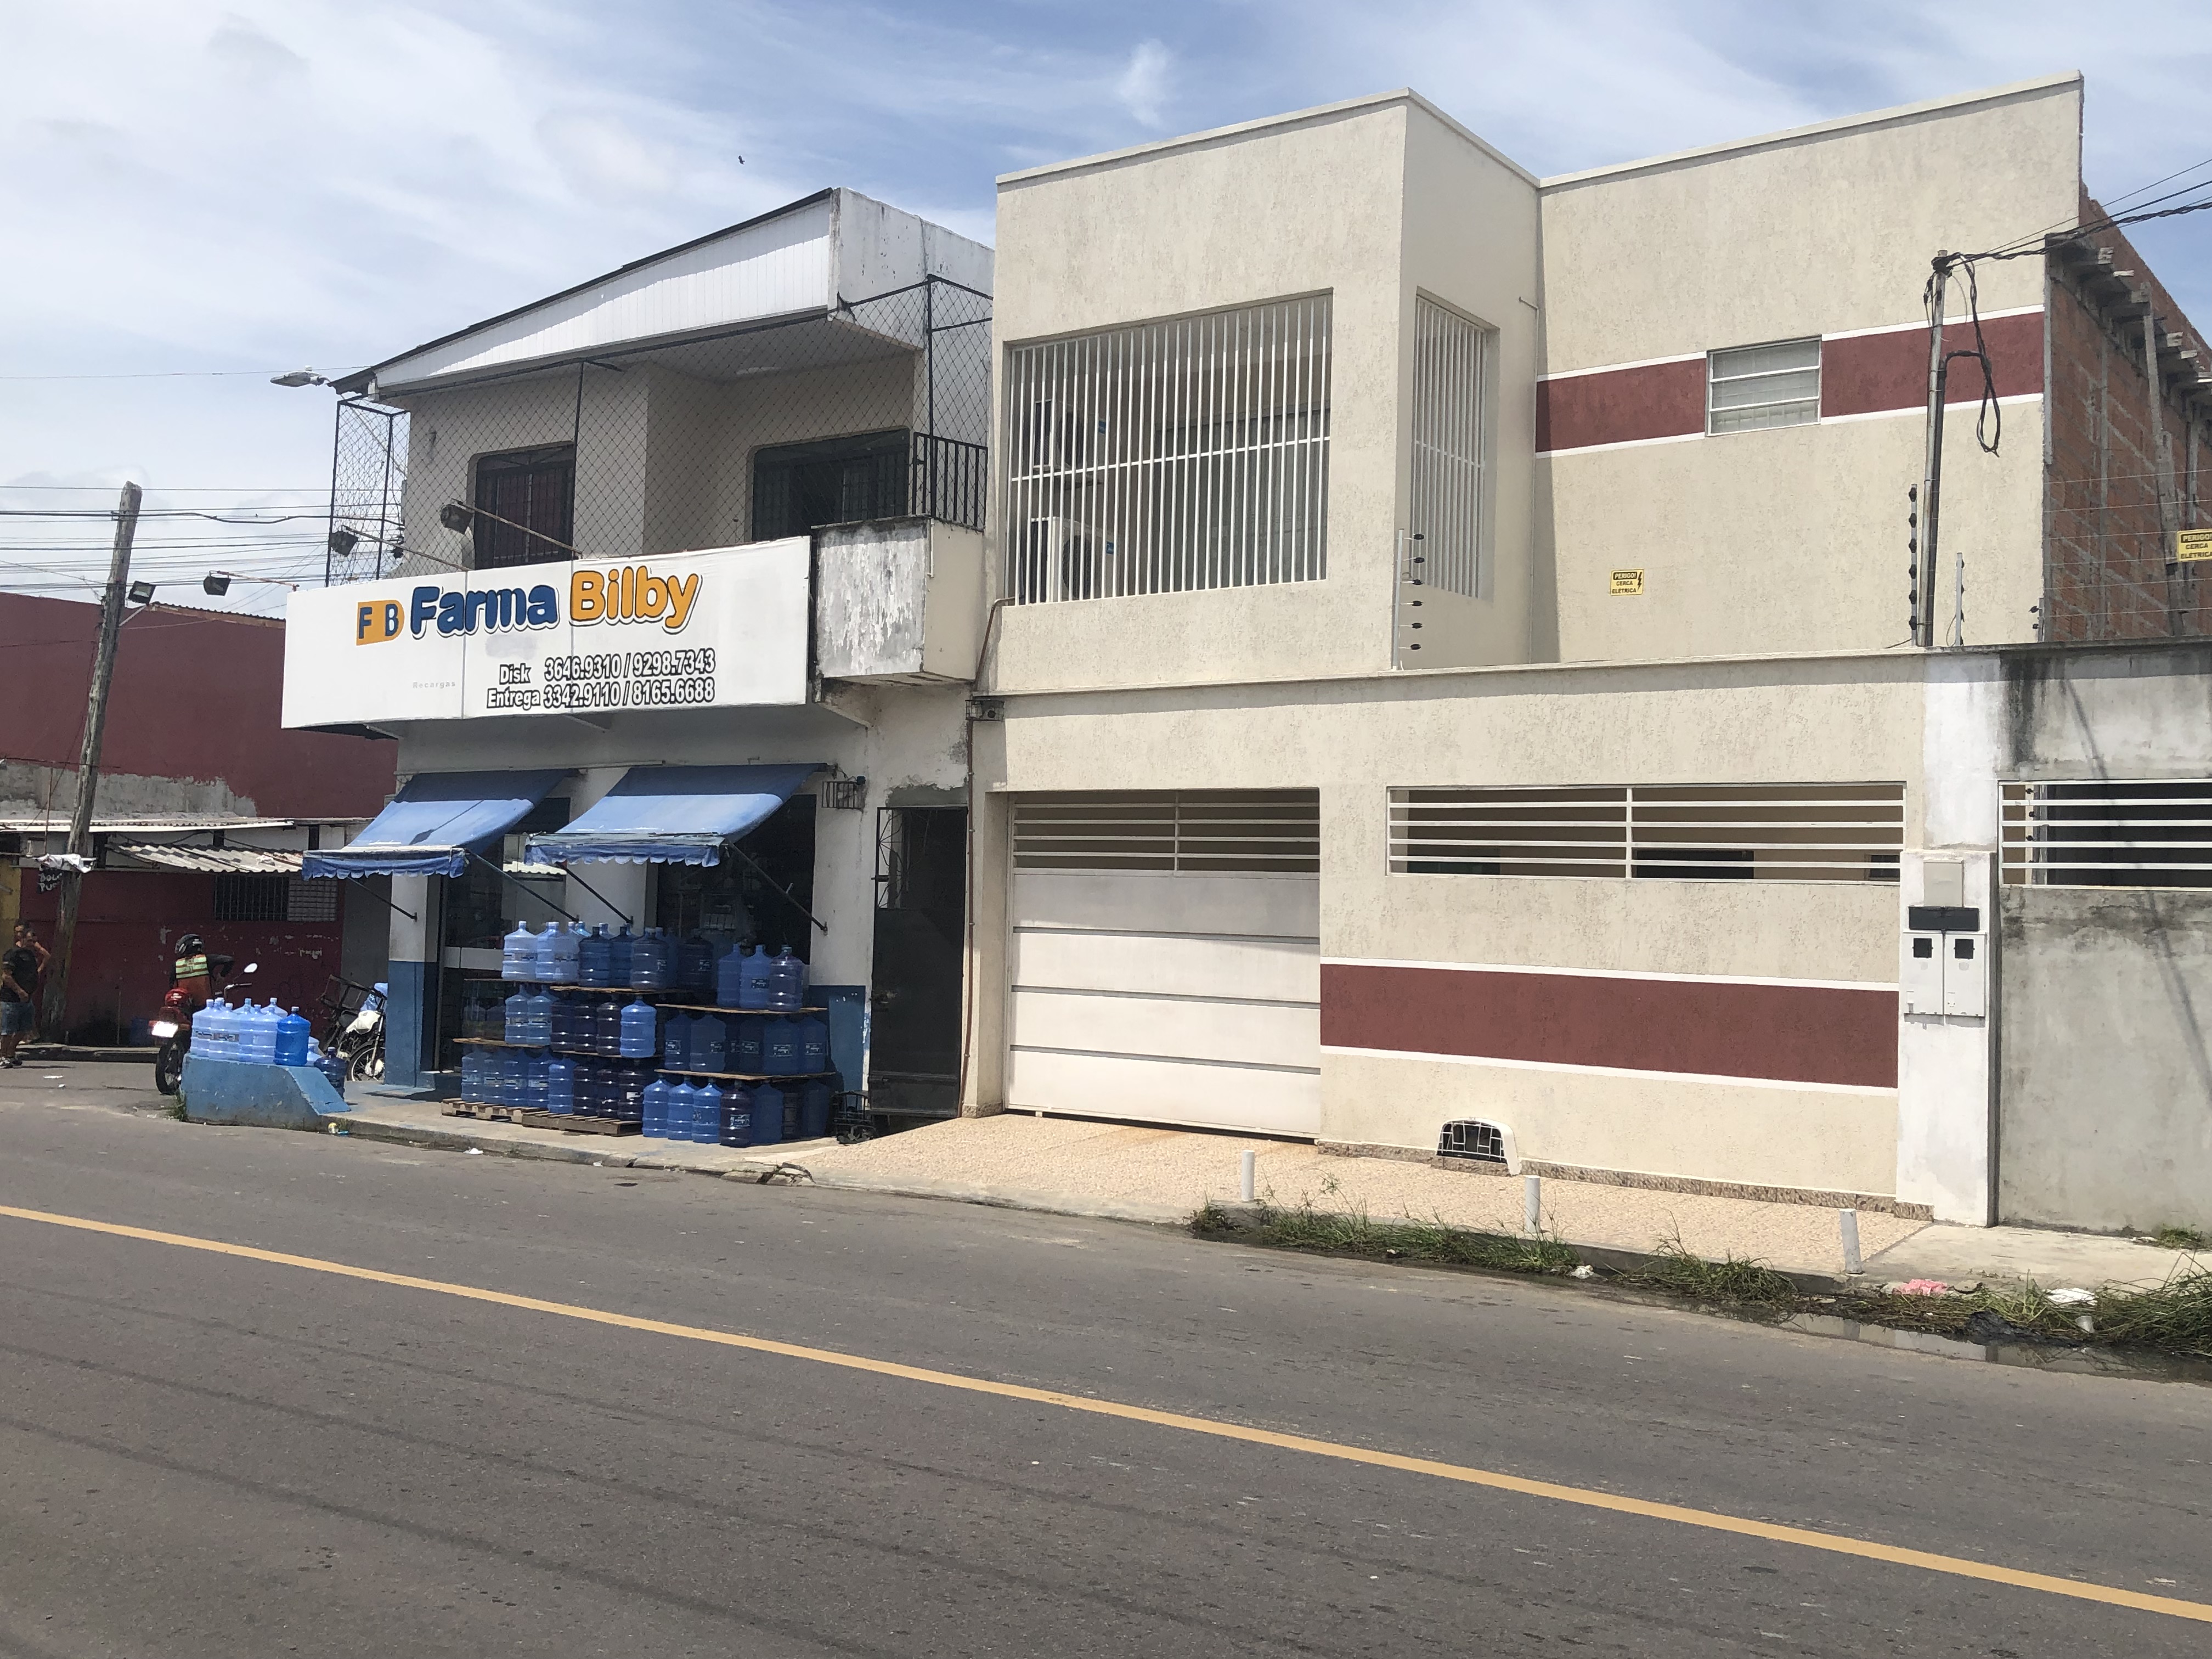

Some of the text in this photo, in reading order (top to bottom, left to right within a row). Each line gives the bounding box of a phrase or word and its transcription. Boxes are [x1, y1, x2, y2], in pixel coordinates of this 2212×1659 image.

[410, 585, 560, 640] Farma
[569, 566, 703, 635] Bilby
[500, 663, 532, 685] Disk
[544, 653, 622, 681] 3646.9310
[633, 647, 715, 678] 9298.7343
[487, 686, 541, 710] Entrega
[543, 681, 621, 709] 3342.9110
[632, 676, 715, 705] 8165.6688
